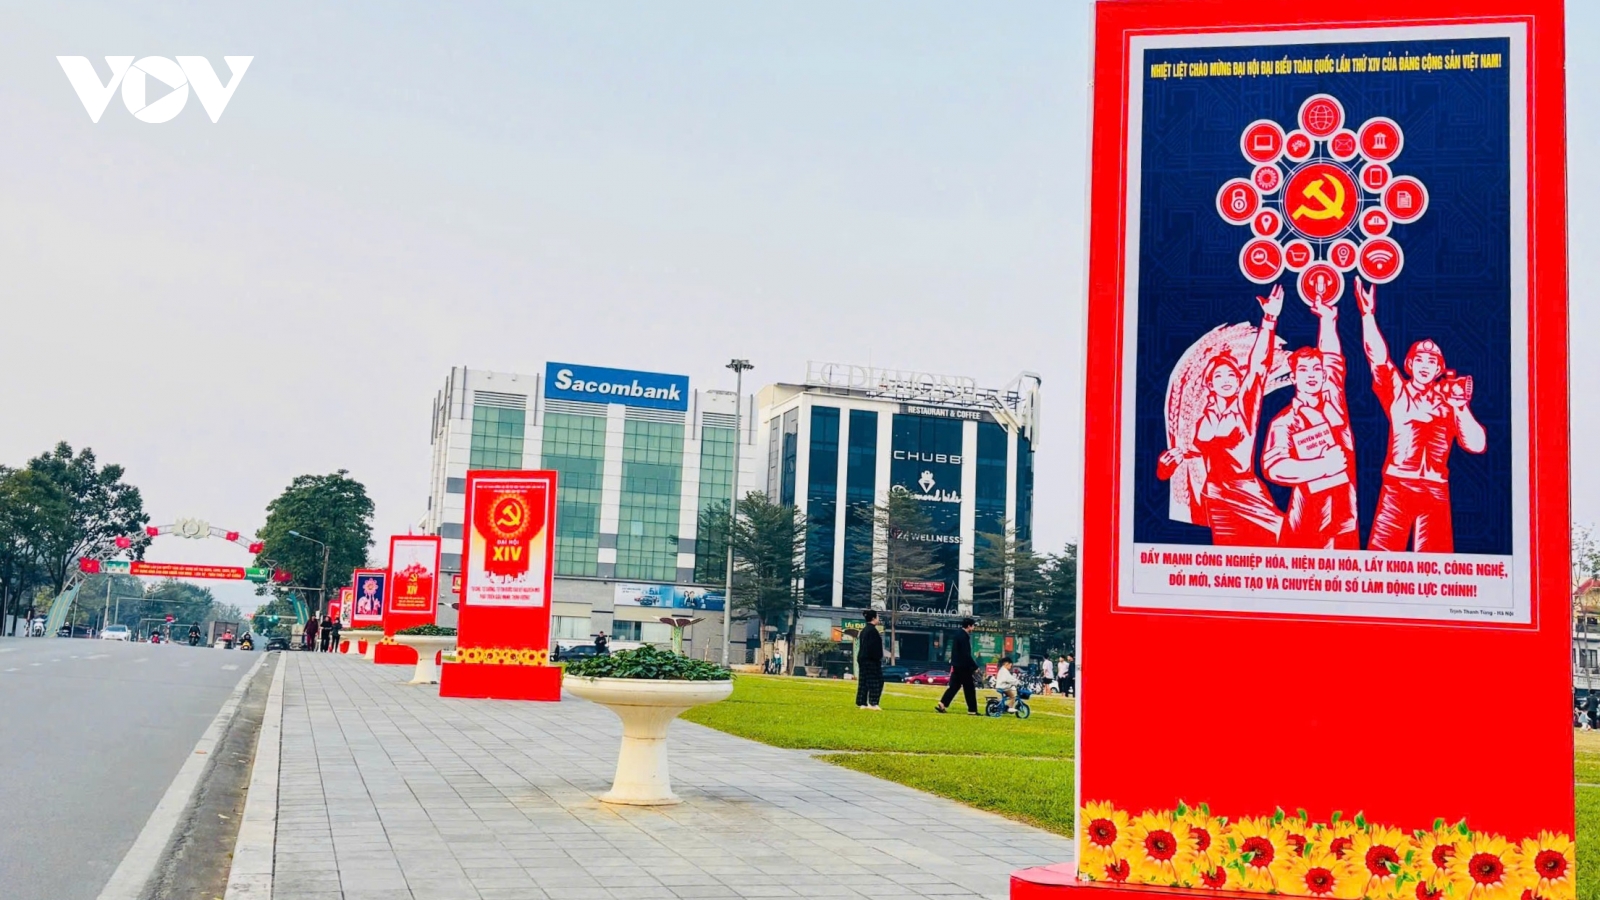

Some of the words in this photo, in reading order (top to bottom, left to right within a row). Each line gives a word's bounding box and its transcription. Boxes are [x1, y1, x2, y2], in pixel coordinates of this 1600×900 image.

[1151, 61, 1171, 80] NHIỆT
[1173, 61, 1189, 80] LIỆT
[1189, 59, 1208, 77] CHÀO
[1209, 58, 1232, 76] MỪNG
[1232, 61, 1245, 78] ĐẠI
[1247, 58, 1260, 78] HỘI
[1260, 60, 1273, 78] ĐẠI
[1293, 56, 1313, 74] TOÀN
[1314, 53, 1335, 75] QUỐC
[1352, 53, 1367, 73] THỨ
[1368, 57, 1381, 72] XIV
[1382, 51, 1398, 71] CỦA
[1399, 50, 1420, 71] ĐẢNG
[1422, 52, 1443, 73] CỘNG
[1444, 49, 1461, 70] SẢN
[1462, 51, 1479, 72] VIỆT
[1480, 53, 1502, 69] NAM!
[554, 368, 682, 401] Sacombank
[849, 365, 979, 401] DIAMOND
[908, 406, 949, 418] RESTAURANT
[950, 410, 955, 418] &
[956, 410, 982, 420] COFFEE
[893, 450, 962, 465] CHUBB
[911, 532, 962, 544] WELLNESS
[492, 545, 523, 562] XIV
[1140, 547, 1160, 565] ĐẨY
[1162, 552, 1192, 568] MẠNH
[1195, 551, 1222, 567] CÔNG
[1225, 553, 1262, 570] NGHIỆP
[1265, 554, 1289, 570] HÓA,
[1291, 555, 1315, 572] HIỆN
[1318, 557, 1335, 573] ĐẠI
[1338, 556, 1362, 573] HÓA,
[1364, 555, 1384, 572] LẤY
[1386, 560, 1414, 574] KHOA
[1417, 561, 1441, 577] HỌC,
[1444, 560, 1473, 576] CÔNG
[1476, 561, 1508, 579] NGHỆ,
[1169, 569, 1186, 586] ĐỔI
[1189, 571, 1211, 588] MỚI,
[1214, 573, 1241, 589] SÁNG
[1244, 576, 1263, 592] TẠO
[1266, 575, 1279, 590] VÀ
[1281, 574, 1322, 592] CHUYỂN
[1324, 575, 1342, 592] ĐỔI
[1345, 575, 1359, 593] SỐ
[1361, 578, 1383, 594] LÀM
[1386, 581, 1415, 597] ĐỘNG
[1418, 581, 1438, 598] LỰC
[1440, 581, 1477, 597] CHÍNH!
